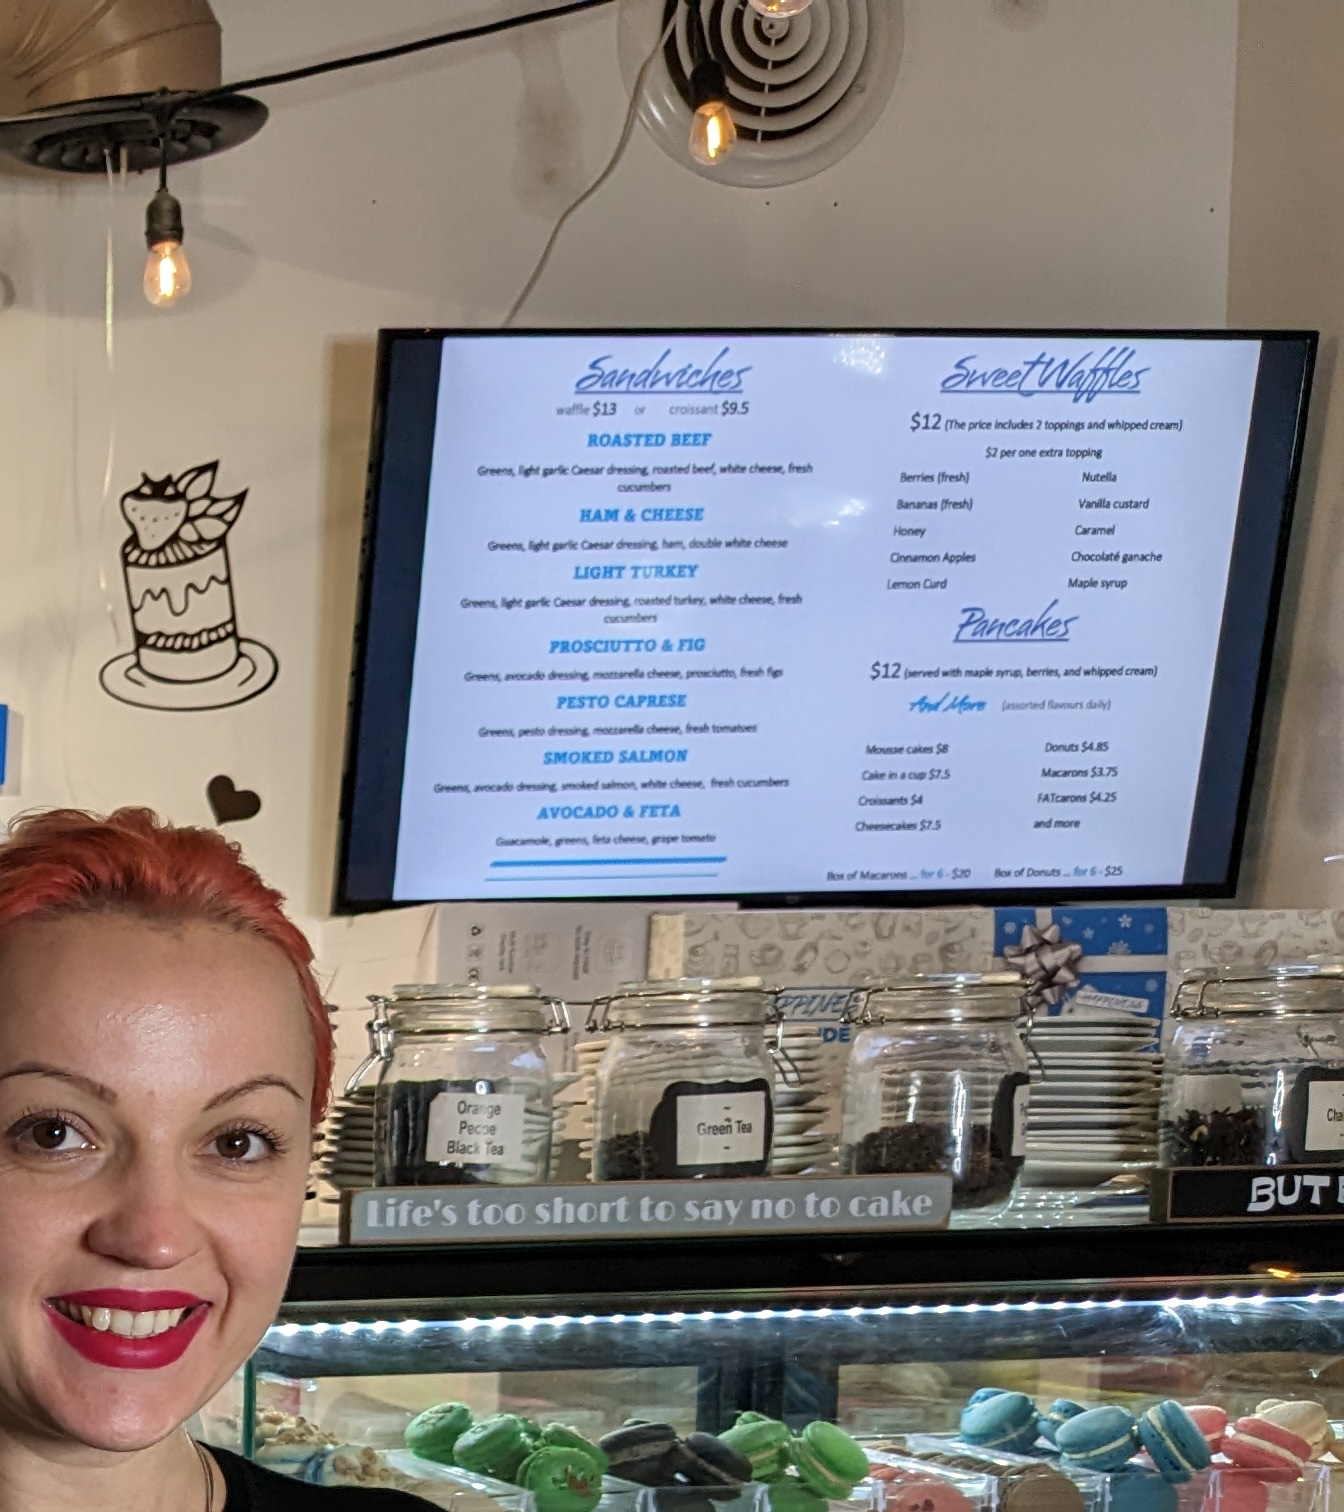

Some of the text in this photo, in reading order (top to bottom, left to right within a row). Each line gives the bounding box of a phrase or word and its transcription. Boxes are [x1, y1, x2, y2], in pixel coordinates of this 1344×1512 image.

[575, 346, 752, 391] Sandwiches
[941, 347, 1150, 403] Sweet Waffles
[556, 401, 749, 417] waffle $13 or croissant $9.5
[588, 432, 712, 447] ROASTED BEEF
[986, 446, 998, 458] $2
[1000, 450, 1016, 459] per
[1039, 449, 1063, 457] extra
[1066, 449, 1102, 459] topping
[1082, 472, 1117, 482] Nutella
[580, 507, 704, 522] HAM & CHEESE
[893, 528, 926, 536] Honey
[574, 564, 698, 579] LIGHT TURKEY
[956, 599, 1078, 639] Pancakes
[550, 638, 706, 653] PROSCIUTTO & FIG
[871, 662, 901, 679] $12
[557, 694, 687, 709] PESTO CAPRESE
[1045, 741, 1109, 752] Donuts $4.85
[543, 749, 688, 764] SMOKED SALMON
[1041, 766, 1118, 777] Macarons $3.75
[537, 804, 681, 819] AVOCADO & FETA
[697, 1120, 752, 1135] Green Tea
[447, 1140, 504, 1155] Black Tea
[1247, 1174, 1330, 1212] BUT
[366, 1190, 932, 1227] Life's too short to say no to cake
